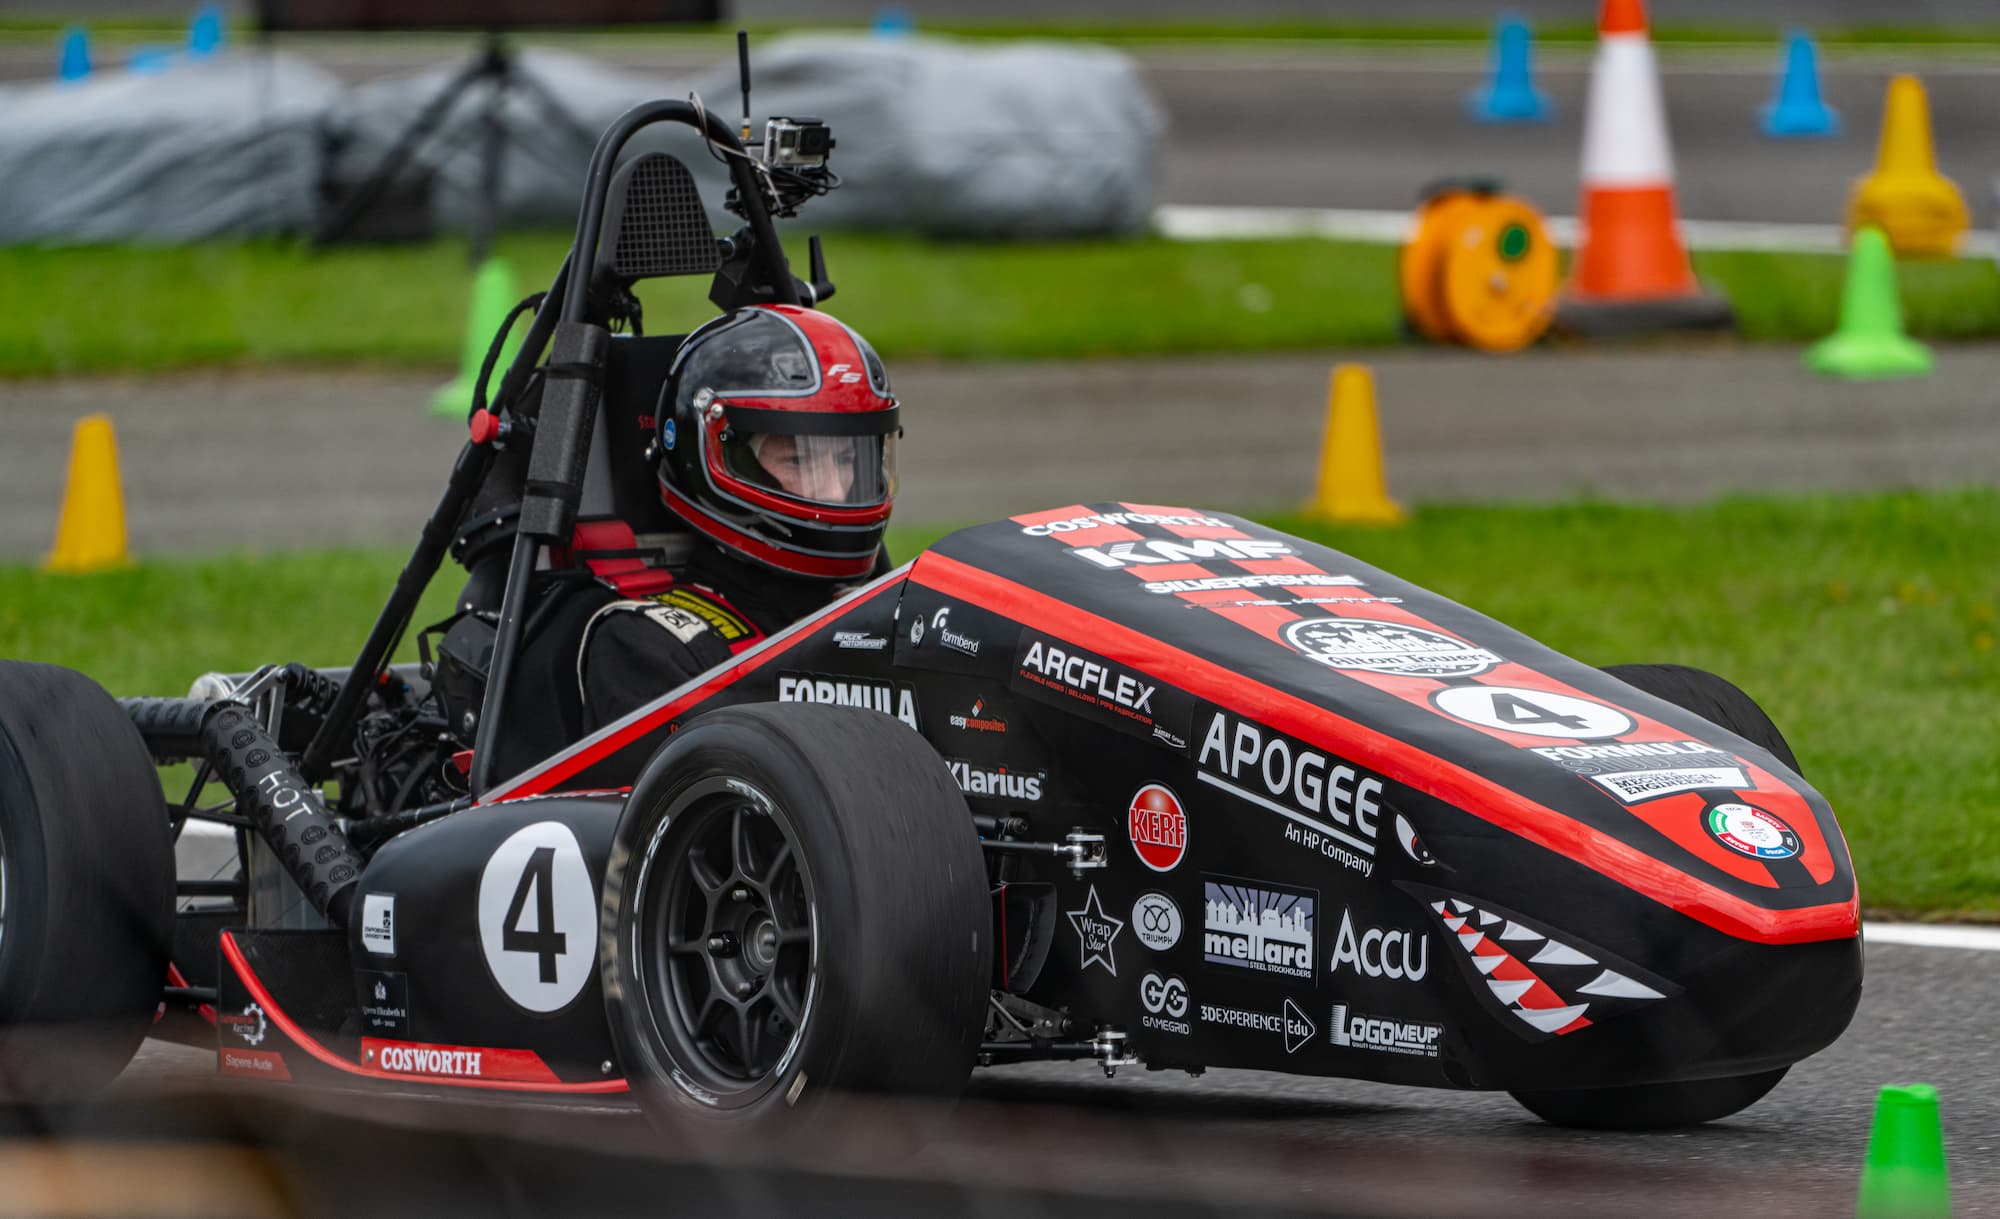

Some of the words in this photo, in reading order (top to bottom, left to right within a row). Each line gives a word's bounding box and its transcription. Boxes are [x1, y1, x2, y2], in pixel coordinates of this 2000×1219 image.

[1022, 512, 1234, 537] COSWORTH
[1073, 539, 1292, 568] KMF
[941, 628, 979, 653] formbend
[1327, 655, 1400, 666] Alton
[1405, 653, 1491, 665] Towers
[1022, 641, 1156, 715] ARCFLEX
[779, 677, 918, 732] FORMULA
[1491, 693, 1591, 730] 4
[1531, 741, 1724, 761] FORMULA
[1198, 712, 1383, 839] APOGEE
[259, 770, 312, 821] HOT
[1129, 808, 1186, 849] KERF
[1285, 822, 1300, 844] An
[1303, 831, 1319, 850] HP
[1321, 838, 1374, 878] Company
[503, 846, 567, 984] 4
[1080, 916, 1111, 941] Wrap
[1086, 934, 1106, 952] Star
[1142, 932, 1173, 945] TRIUMPH
[1204, 931, 1313, 970] mellard
[1331, 907, 1427, 982] ACCU
[1249, 961, 1267, 971] STEEL
[1267, 964, 1312, 979] STOCKHOLDERS
[1142, 1016, 1190, 1035] GAMEGRID
[1200, 1005, 1282, 1033] 3DEXPERIENCE
[1287, 1019, 1309, 1037] Edu
[381, 1047, 482, 1075] COSWORTH
